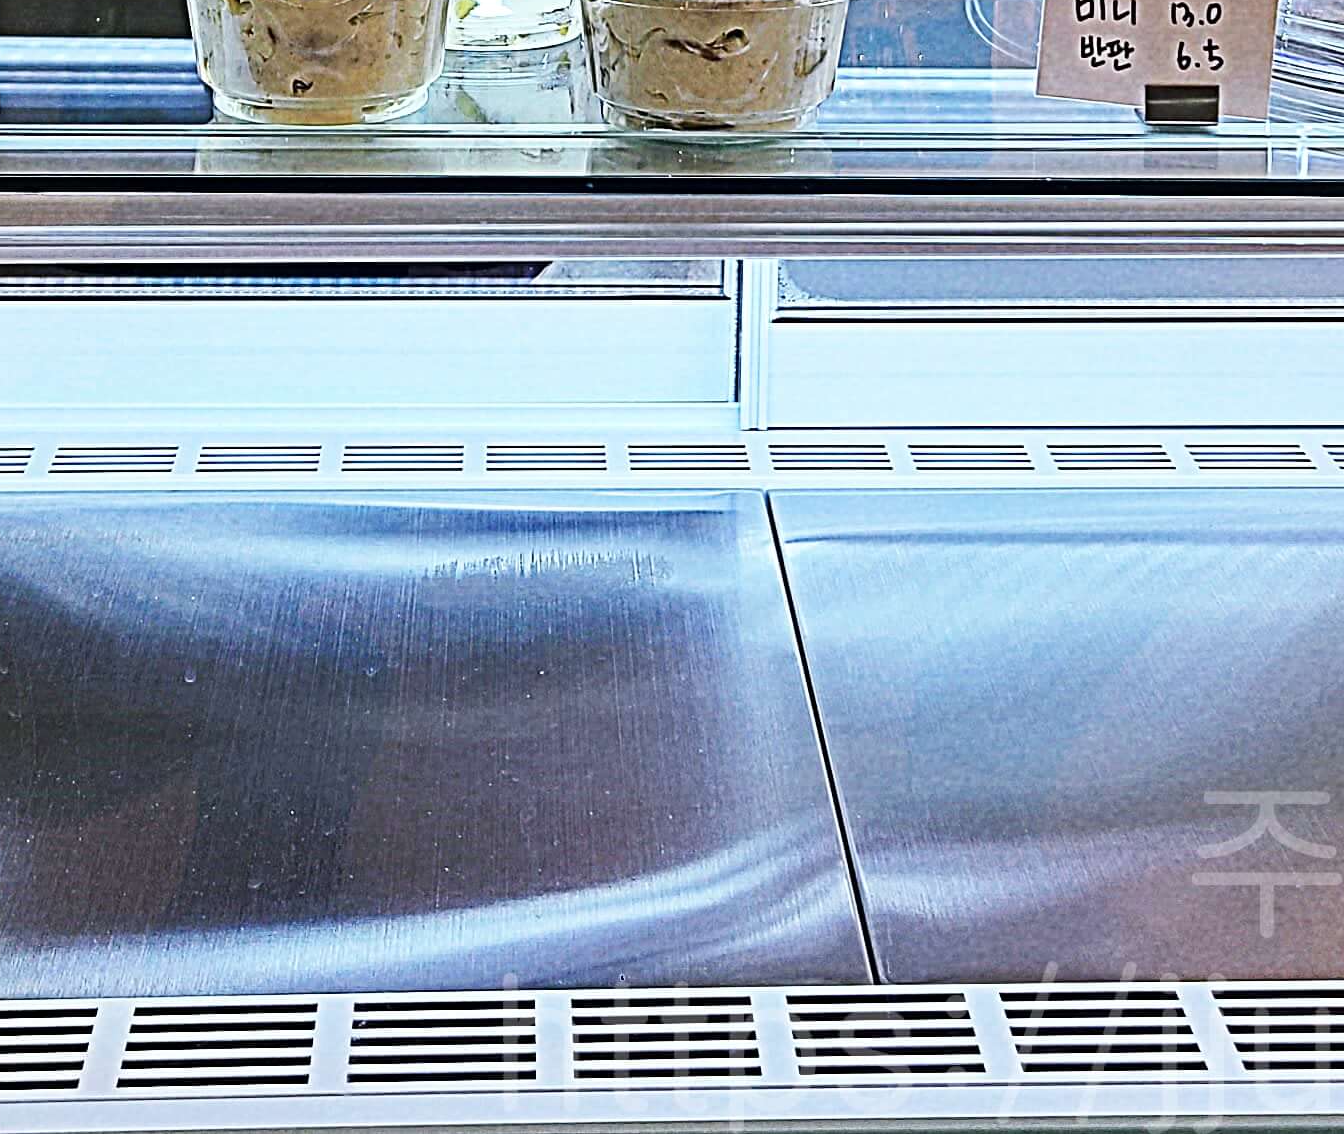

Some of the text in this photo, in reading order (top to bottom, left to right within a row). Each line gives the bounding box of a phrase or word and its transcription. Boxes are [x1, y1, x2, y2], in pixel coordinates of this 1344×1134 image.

[1171, 1, 1223, 28] 13.0
[1080, 35, 1225, 71] 반판 6.5
